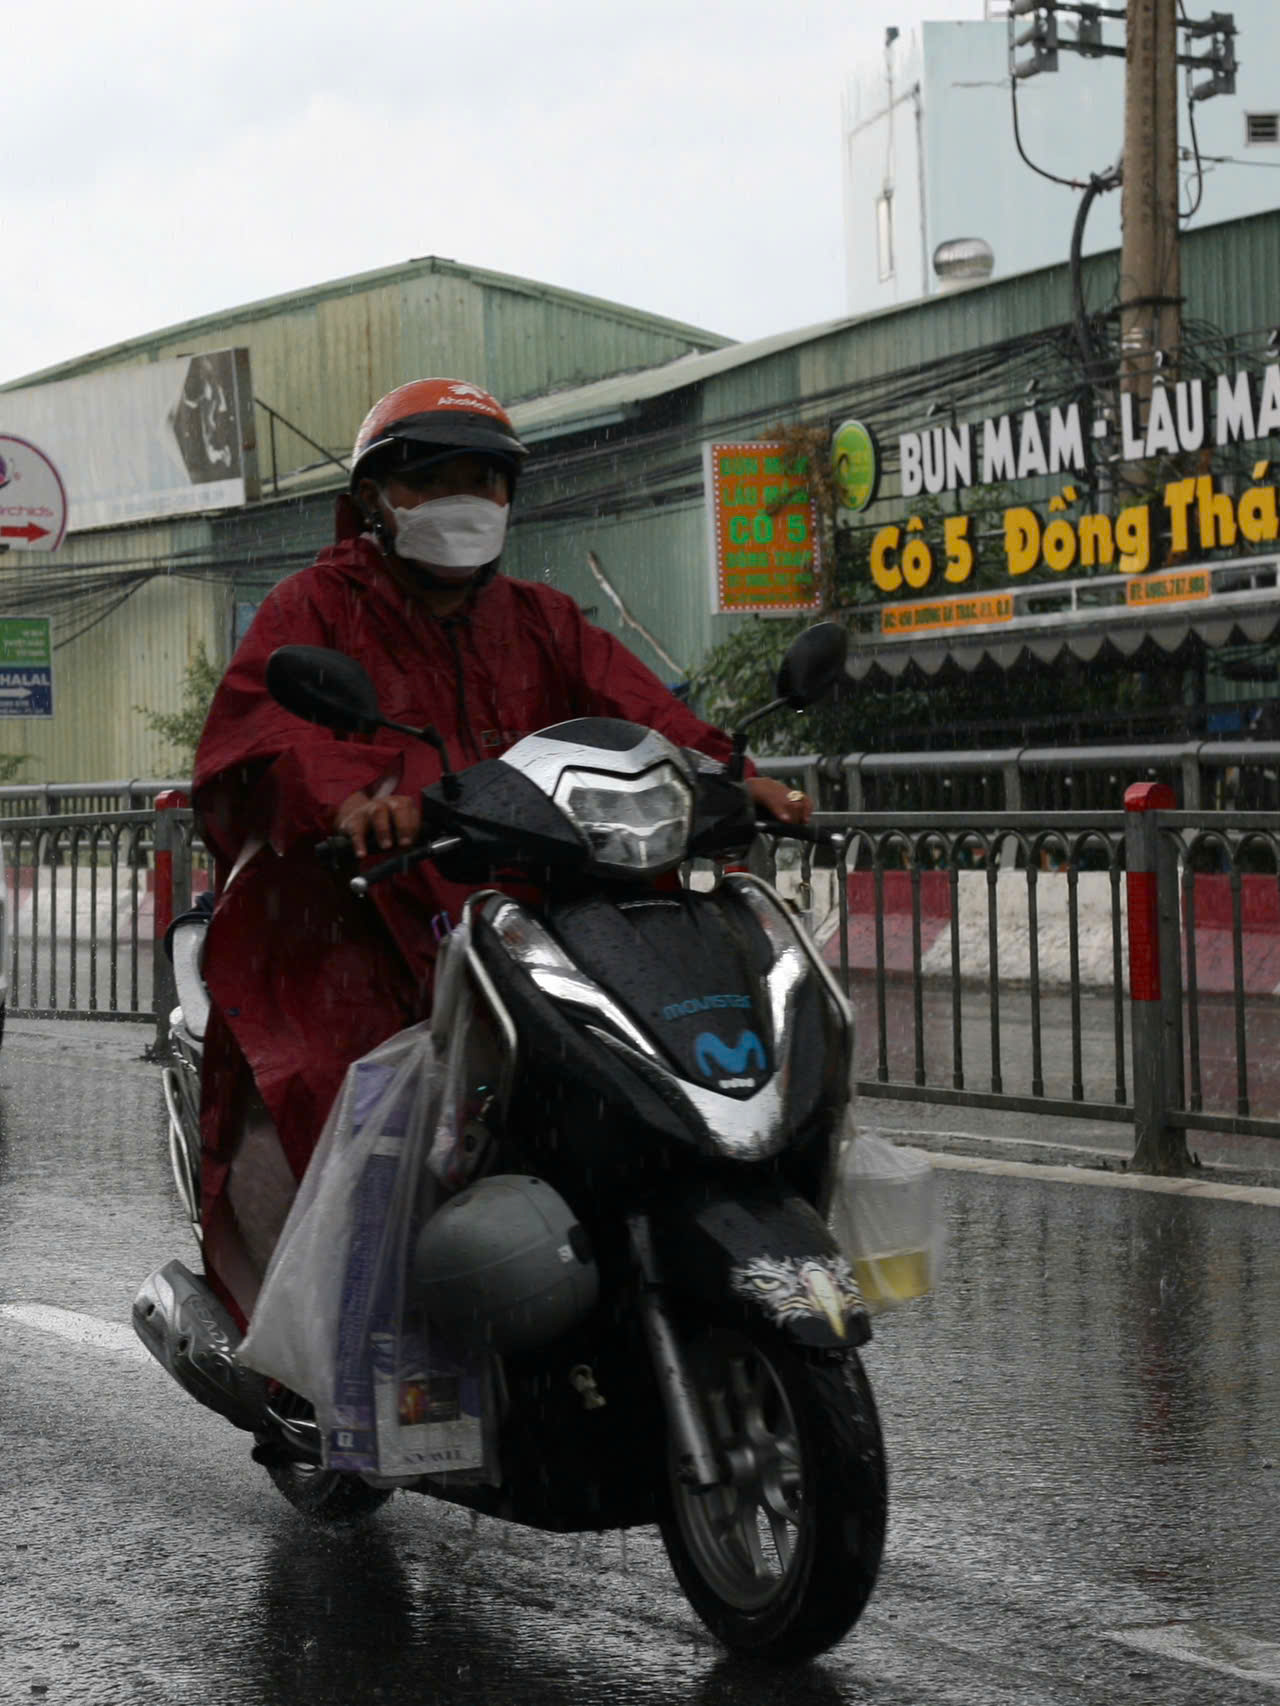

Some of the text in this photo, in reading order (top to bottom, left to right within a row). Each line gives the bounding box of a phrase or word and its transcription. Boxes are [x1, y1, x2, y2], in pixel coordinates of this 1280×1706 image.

[982, 379, 1085, 484] MẮM
[1121, 350, 1204, 461] LẨU
[730, 509, 807, 544] CÔ 5
[870, 516, 932, 592] Cô
[944, 516, 973, 583] 5
[1003, 485, 1150, 575] Đồng
[0, 673, 51, 687] HALAL
